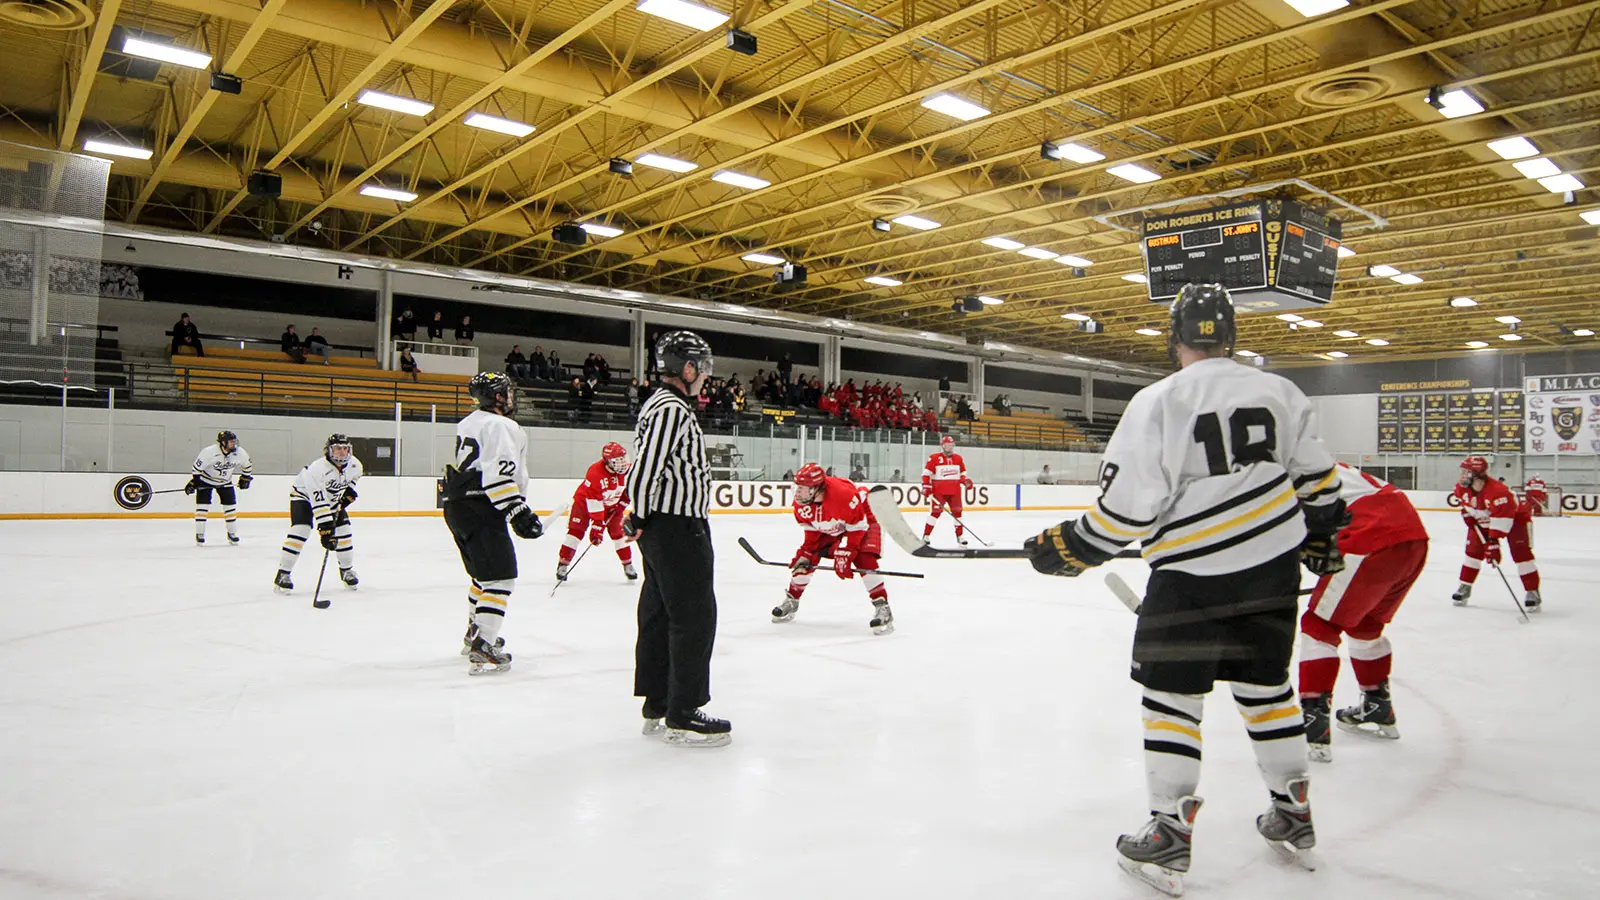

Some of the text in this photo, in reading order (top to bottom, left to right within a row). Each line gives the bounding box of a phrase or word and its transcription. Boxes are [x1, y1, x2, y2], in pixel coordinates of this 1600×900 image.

[1146, 205, 1260, 231] DON ROBERTS ICE RINK
[1239, 253, 1260, 262] PENALTY
[1265, 221, 1281, 285] GUSTIES
[1197, 320, 1215, 335] 18
[1381, 379, 1470, 391] CONFERENCE CHAMPIONSHIPS
[938, 456, 944, 464] 3
[498, 460, 516, 476] 22
[313, 490, 326, 502] 21
[715, 484, 791, 507] GUST
[797, 505, 814, 519] 22
